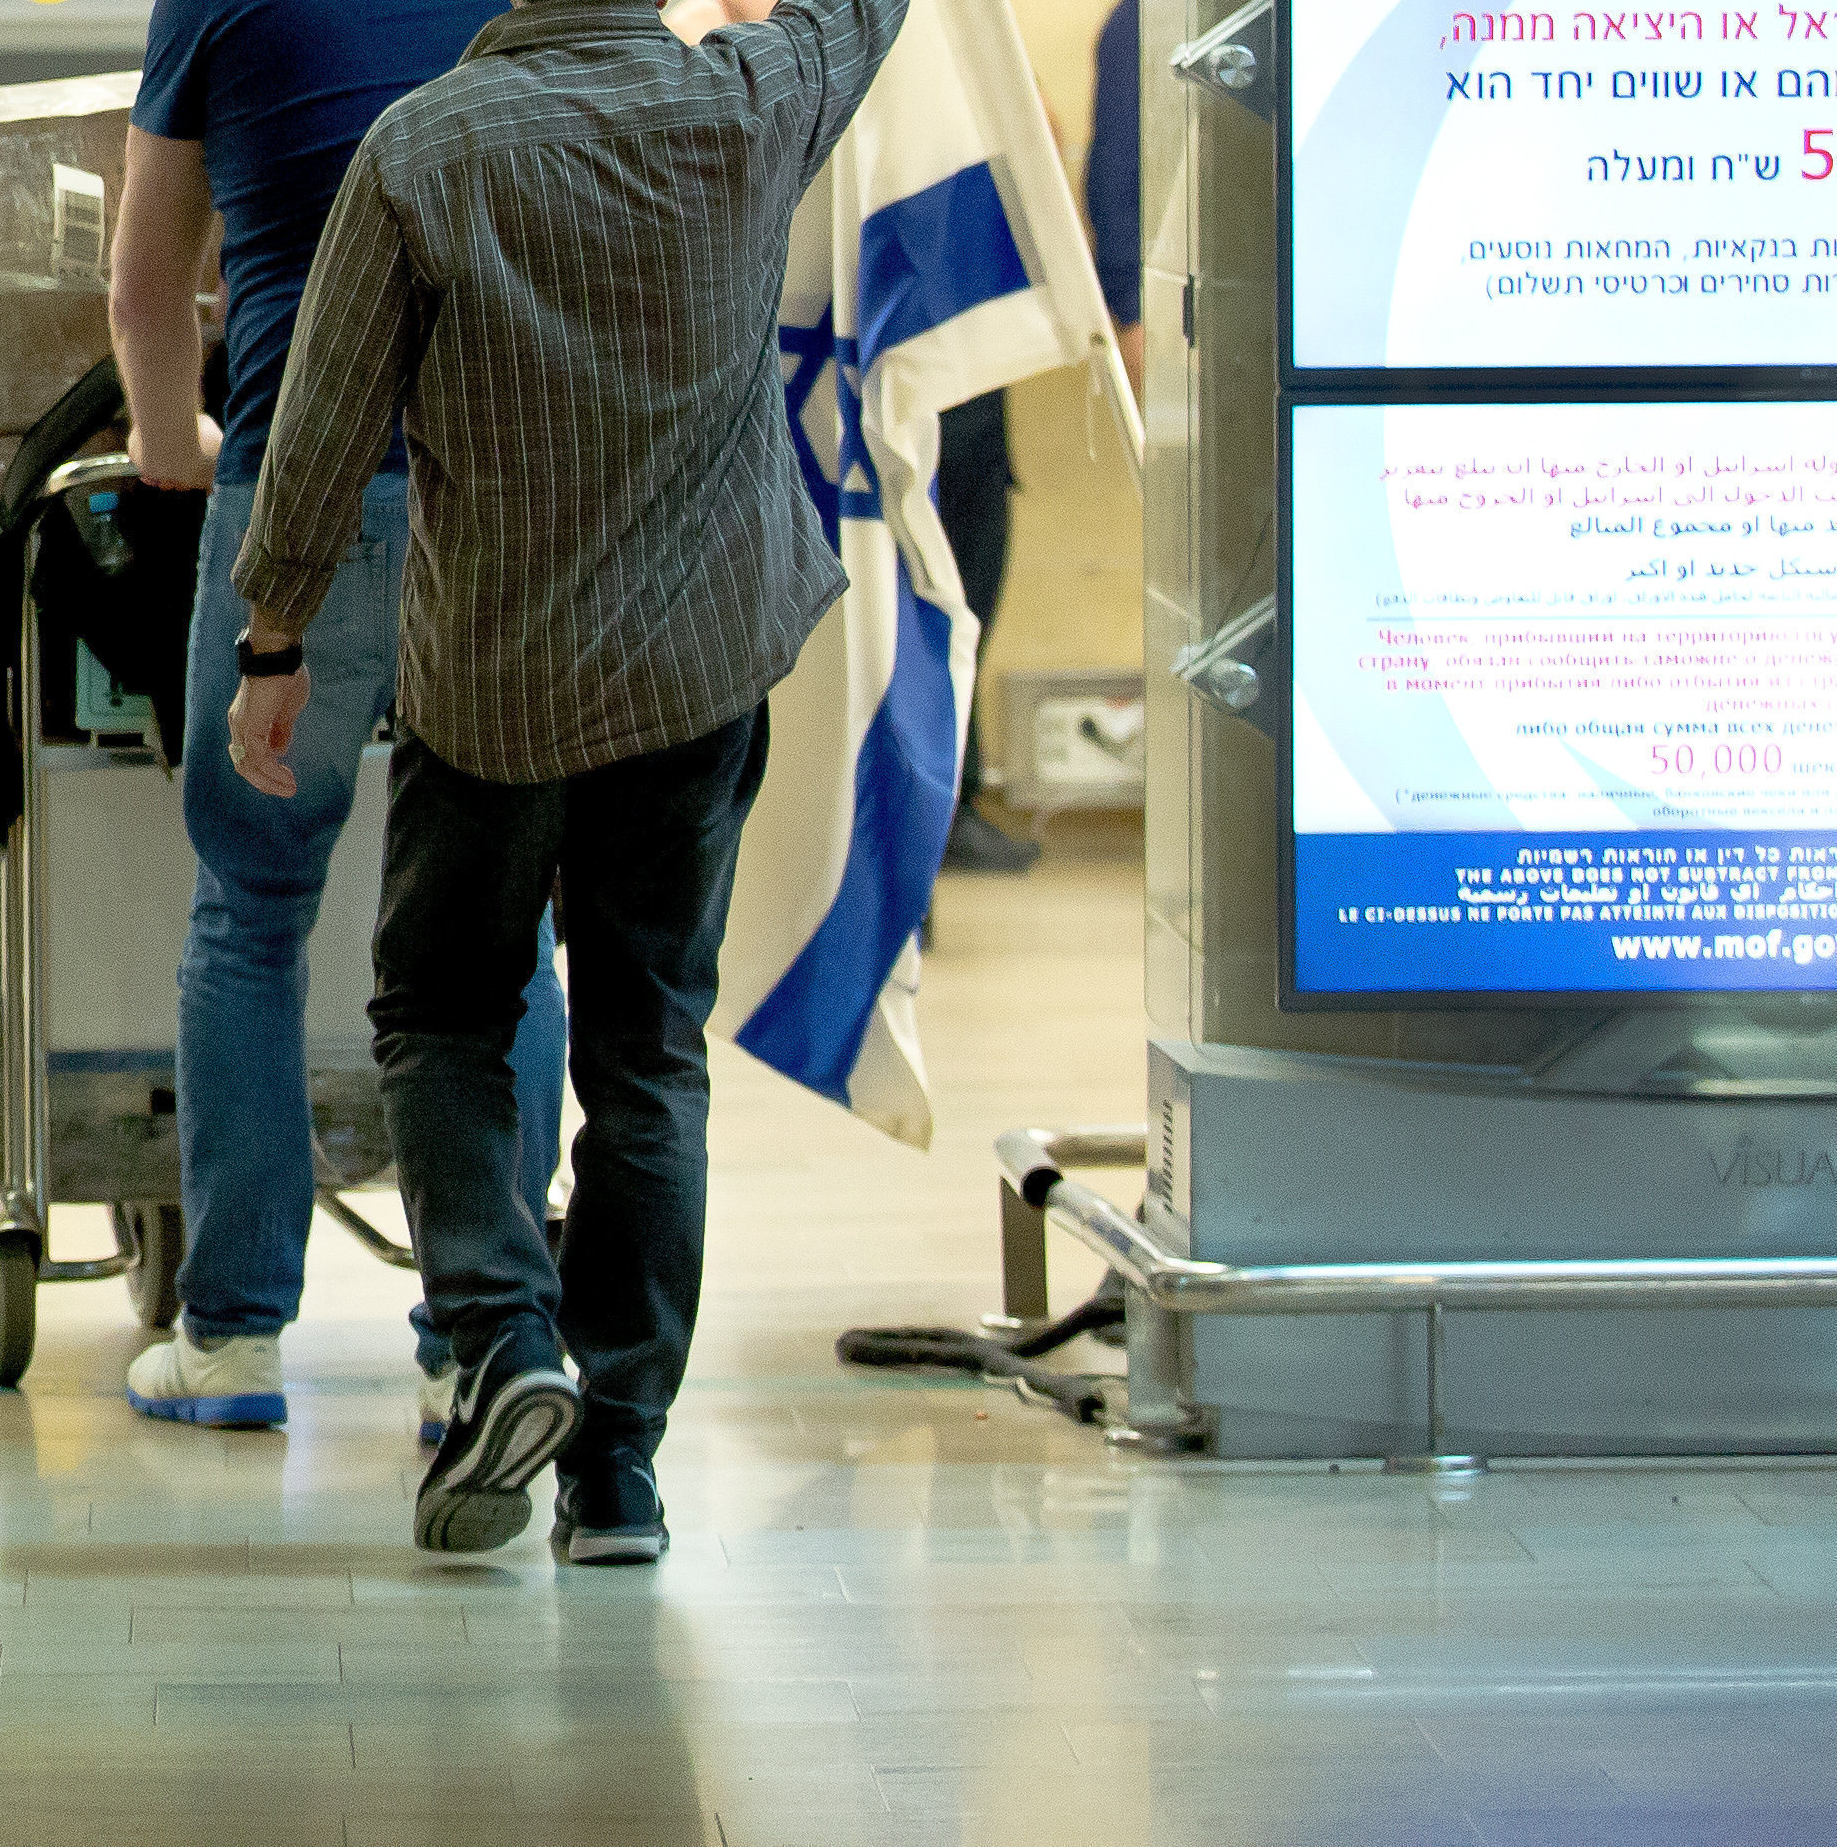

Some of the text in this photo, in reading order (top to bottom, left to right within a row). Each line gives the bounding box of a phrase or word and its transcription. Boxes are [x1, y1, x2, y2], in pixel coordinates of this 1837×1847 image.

[1438, 11, 1758, 51] או היציאה ממנה,
[1445, 69, 1757, 101] או שווים יחד הוא
[1587, 150, 1693, 183] ומעלה
[1564, 238, 1671, 260] המחאות
[1596, 274, 1689, 295] וכרטיסי
[1701, 274, 1790, 294] סחירים
[1651, 743, 1784, 779] 50,000
[1454, 867, 1493, 884] THE
[1500, 867, 1564, 884] ABOVE
[1570, 864, 1625, 885] DOES
[1630, 866, 1671, 883] NOT
[1678, 866, 1779, 883] SUBTRACT
[1337, 905, 1359, 924] LE
[1467, 905, 1490, 923] NE
[1497, 905, 1553, 923] PORTE
[1559, 905, 1594, 922] PAS
[1599, 905, 1685, 921] ATTEINTE
[1691, 905, 1727, 920] AUX
[1611, 928, 1837, 965] www.mof.go
